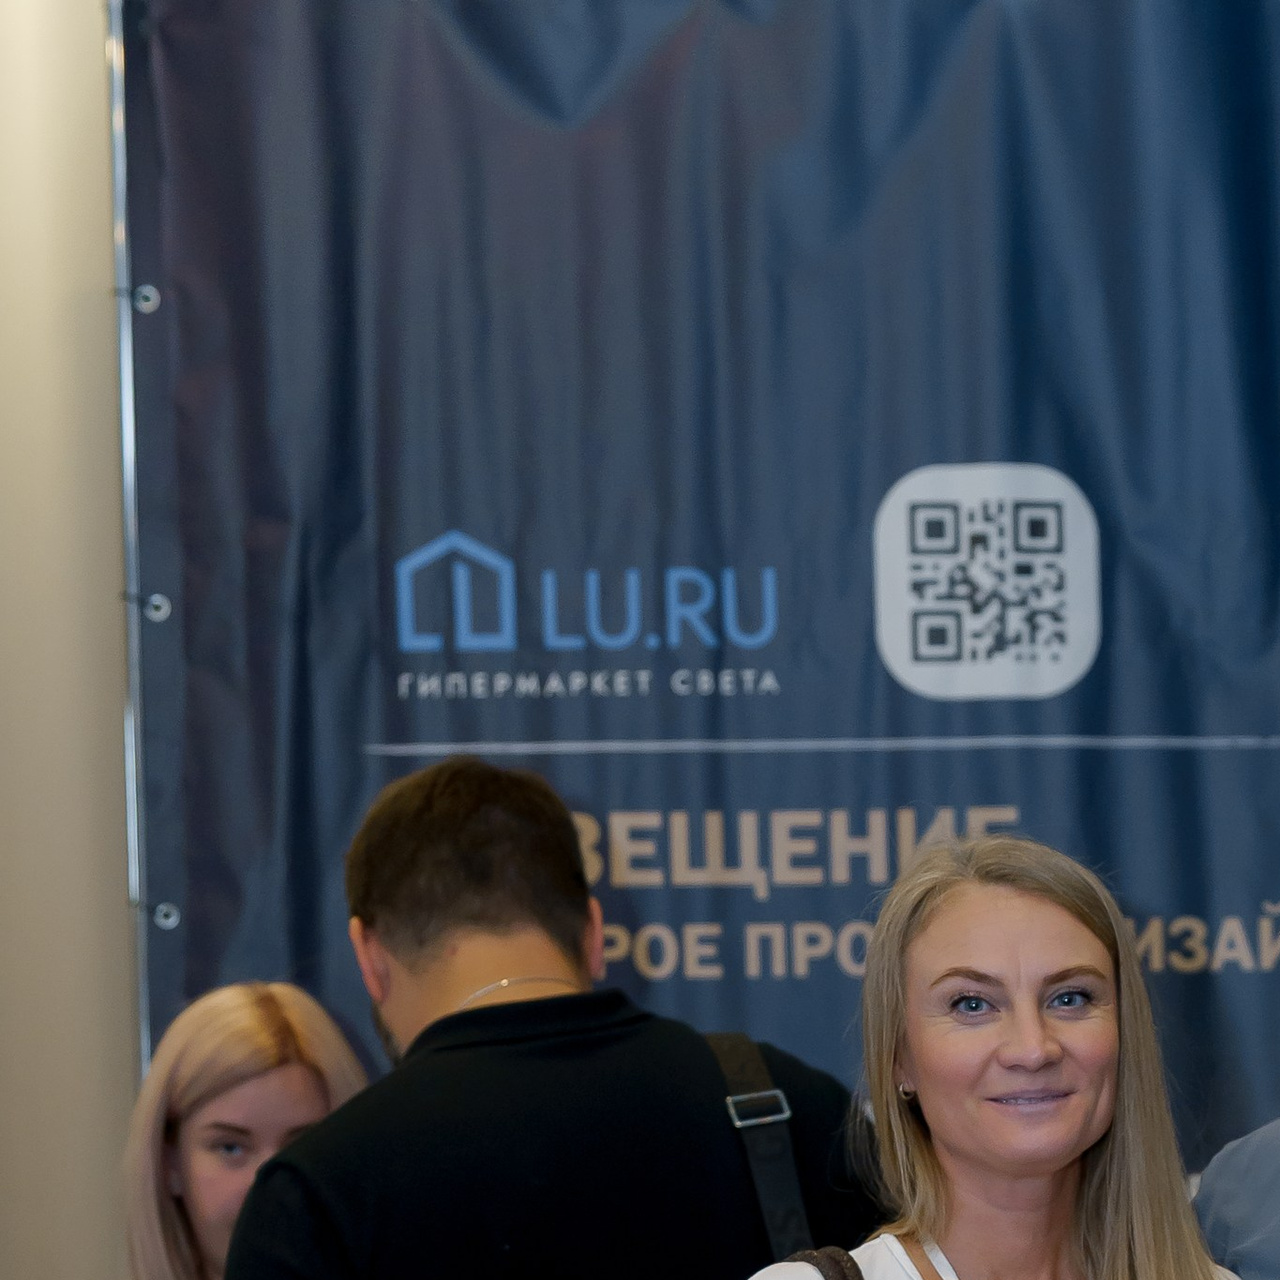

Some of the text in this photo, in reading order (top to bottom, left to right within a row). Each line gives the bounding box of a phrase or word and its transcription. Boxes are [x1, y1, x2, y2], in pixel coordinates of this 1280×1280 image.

[541, 566, 778, 650] LU.RU
[398, 668, 781, 699] ГИПЕРМАРКЕТ СВЕТА
